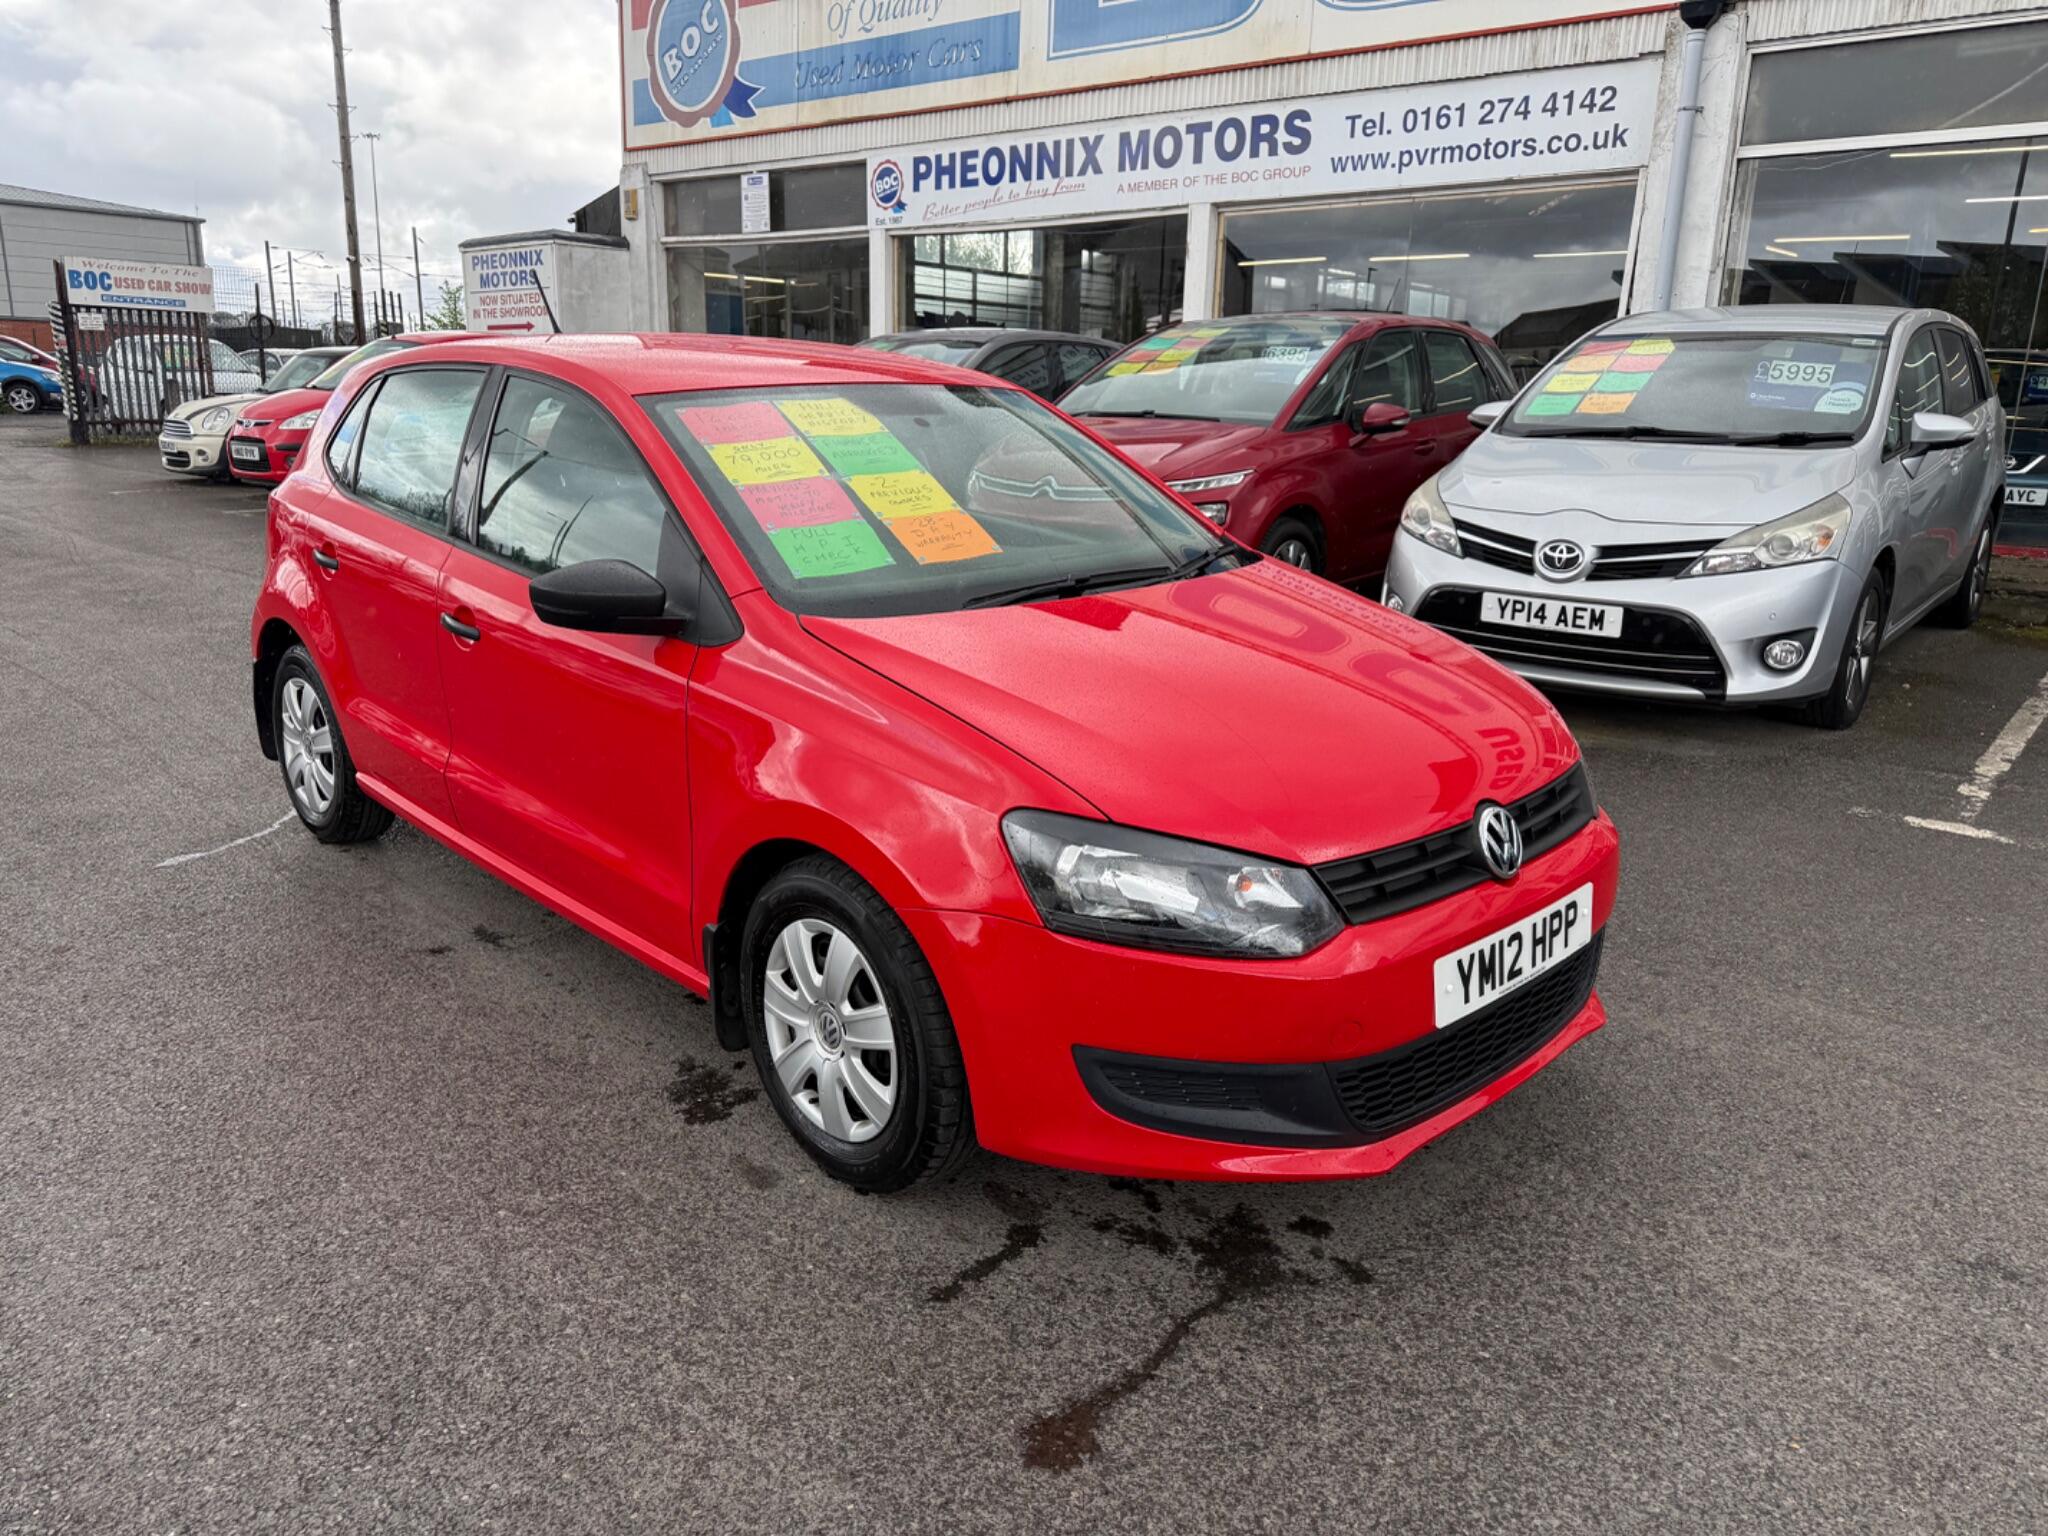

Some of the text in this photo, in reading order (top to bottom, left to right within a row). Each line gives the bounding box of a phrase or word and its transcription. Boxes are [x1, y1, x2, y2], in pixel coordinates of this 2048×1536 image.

[827, 2, 852, 38] Of
[663, 0, 719, 81] BOC
[795, 37, 984, 89] Used Motor Cars
[1345, 85, 1618, 139] Tel. 0161 274 4142
[913, 109, 1312, 193] PHEONNIX MOTORS
[1331, 122, 1629, 174] www.pvrmotors.co.uk
[875, 173, 899, 193] BOC
[1117, 165, 1312, 194] A MEMBER OF THE BOC GROUP
[922, 176, 1086, 222] Better people to buy from
[82, 260, 200, 277] Welcome To The
[472, 249, 544, 271] PHEONNIX
[68, 269, 211, 295] BOC USED CAR SHOW
[480, 269, 538, 289] MOTORS
[102, 295, 185, 306] ENTRANCE
[480, 292, 540, 306] NOW SITUATED
[473, 309, 481, 319] IN
[482, 307, 498, 319] THE
[870, 483, 934, 499] PREVIOUS
[2006, 489, 2037, 503] AYC
[791, 528, 837, 540] FULL
[803, 546, 864, 564] CHECK
[1497, 598, 1605, 632] YP14 AEM
[1457, 931, 1523, 1005] YM12
[1532, 900, 1578, 968] HPP
